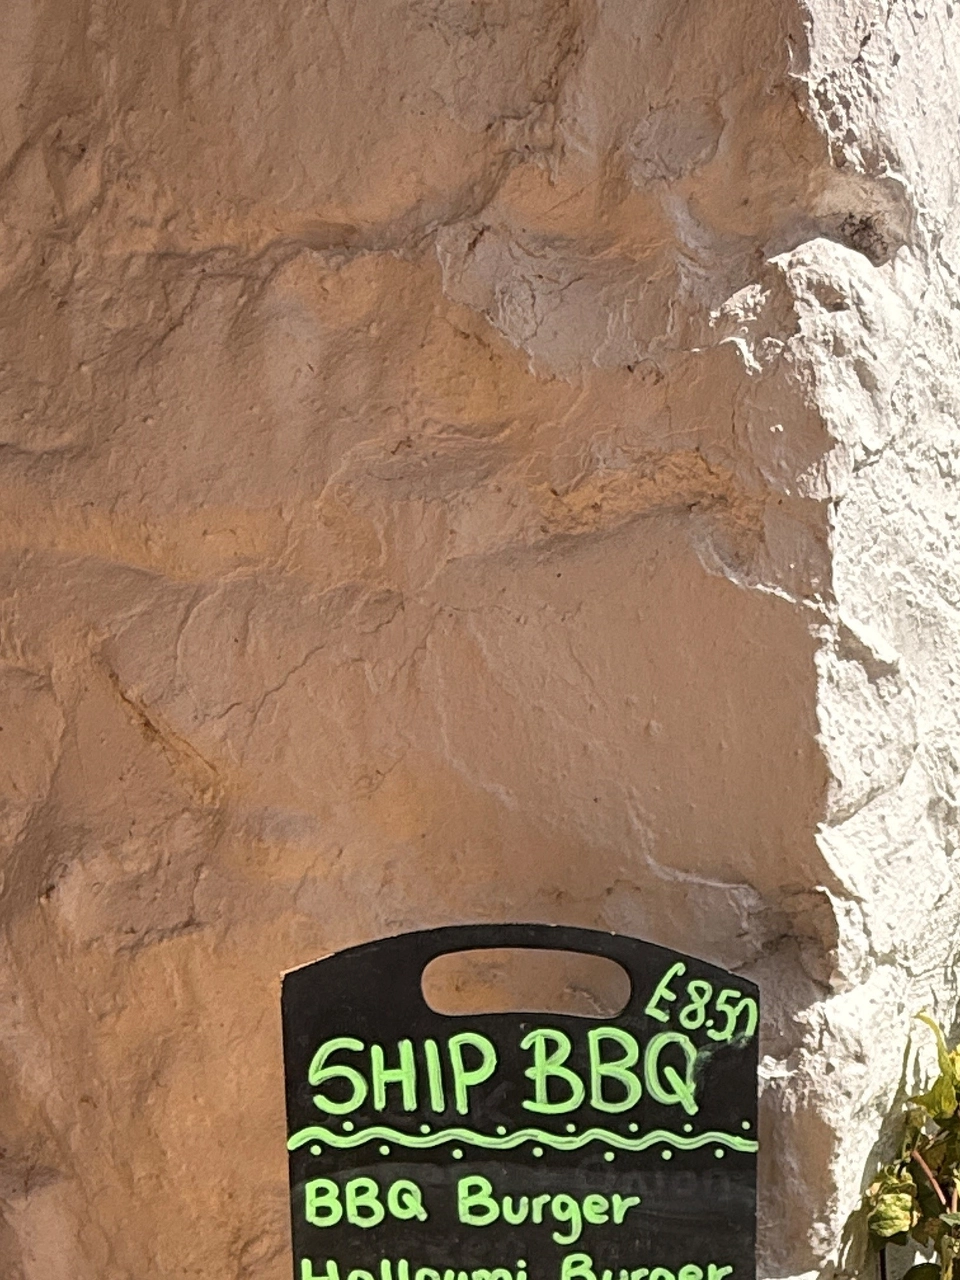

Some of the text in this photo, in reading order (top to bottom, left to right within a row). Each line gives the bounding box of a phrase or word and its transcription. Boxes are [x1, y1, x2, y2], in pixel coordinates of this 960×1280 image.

[308, 1027, 700, 1115] SHIP BBQ
[304, 1175, 641, 1245] BBQ Burger
